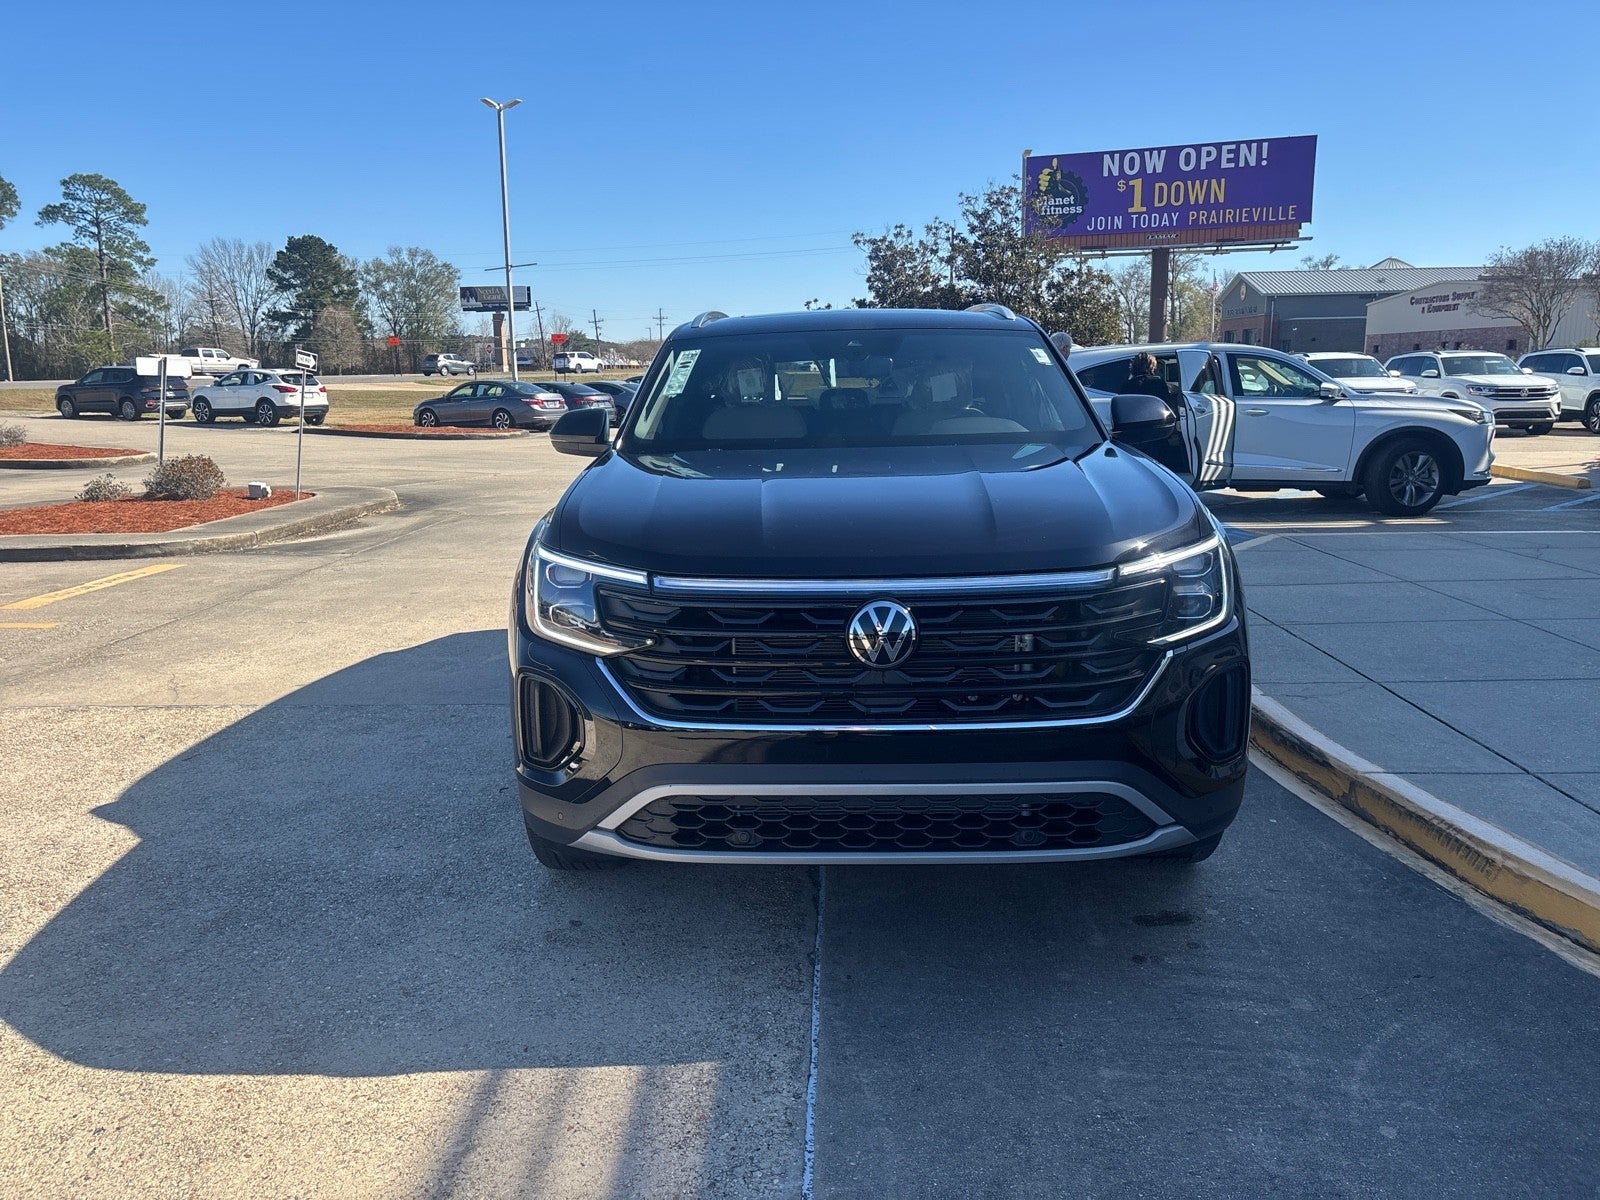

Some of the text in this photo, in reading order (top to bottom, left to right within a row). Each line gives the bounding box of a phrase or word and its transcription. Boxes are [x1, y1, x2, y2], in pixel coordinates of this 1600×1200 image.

[1102, 142, 1269, 177] NOW OPEN!
[1153, 178, 1226, 208] DOWN
[1040, 205, 1083, 216] fitness
[1086, 204, 1297, 231] JOIN TODAY PRAIRIEVILLE
